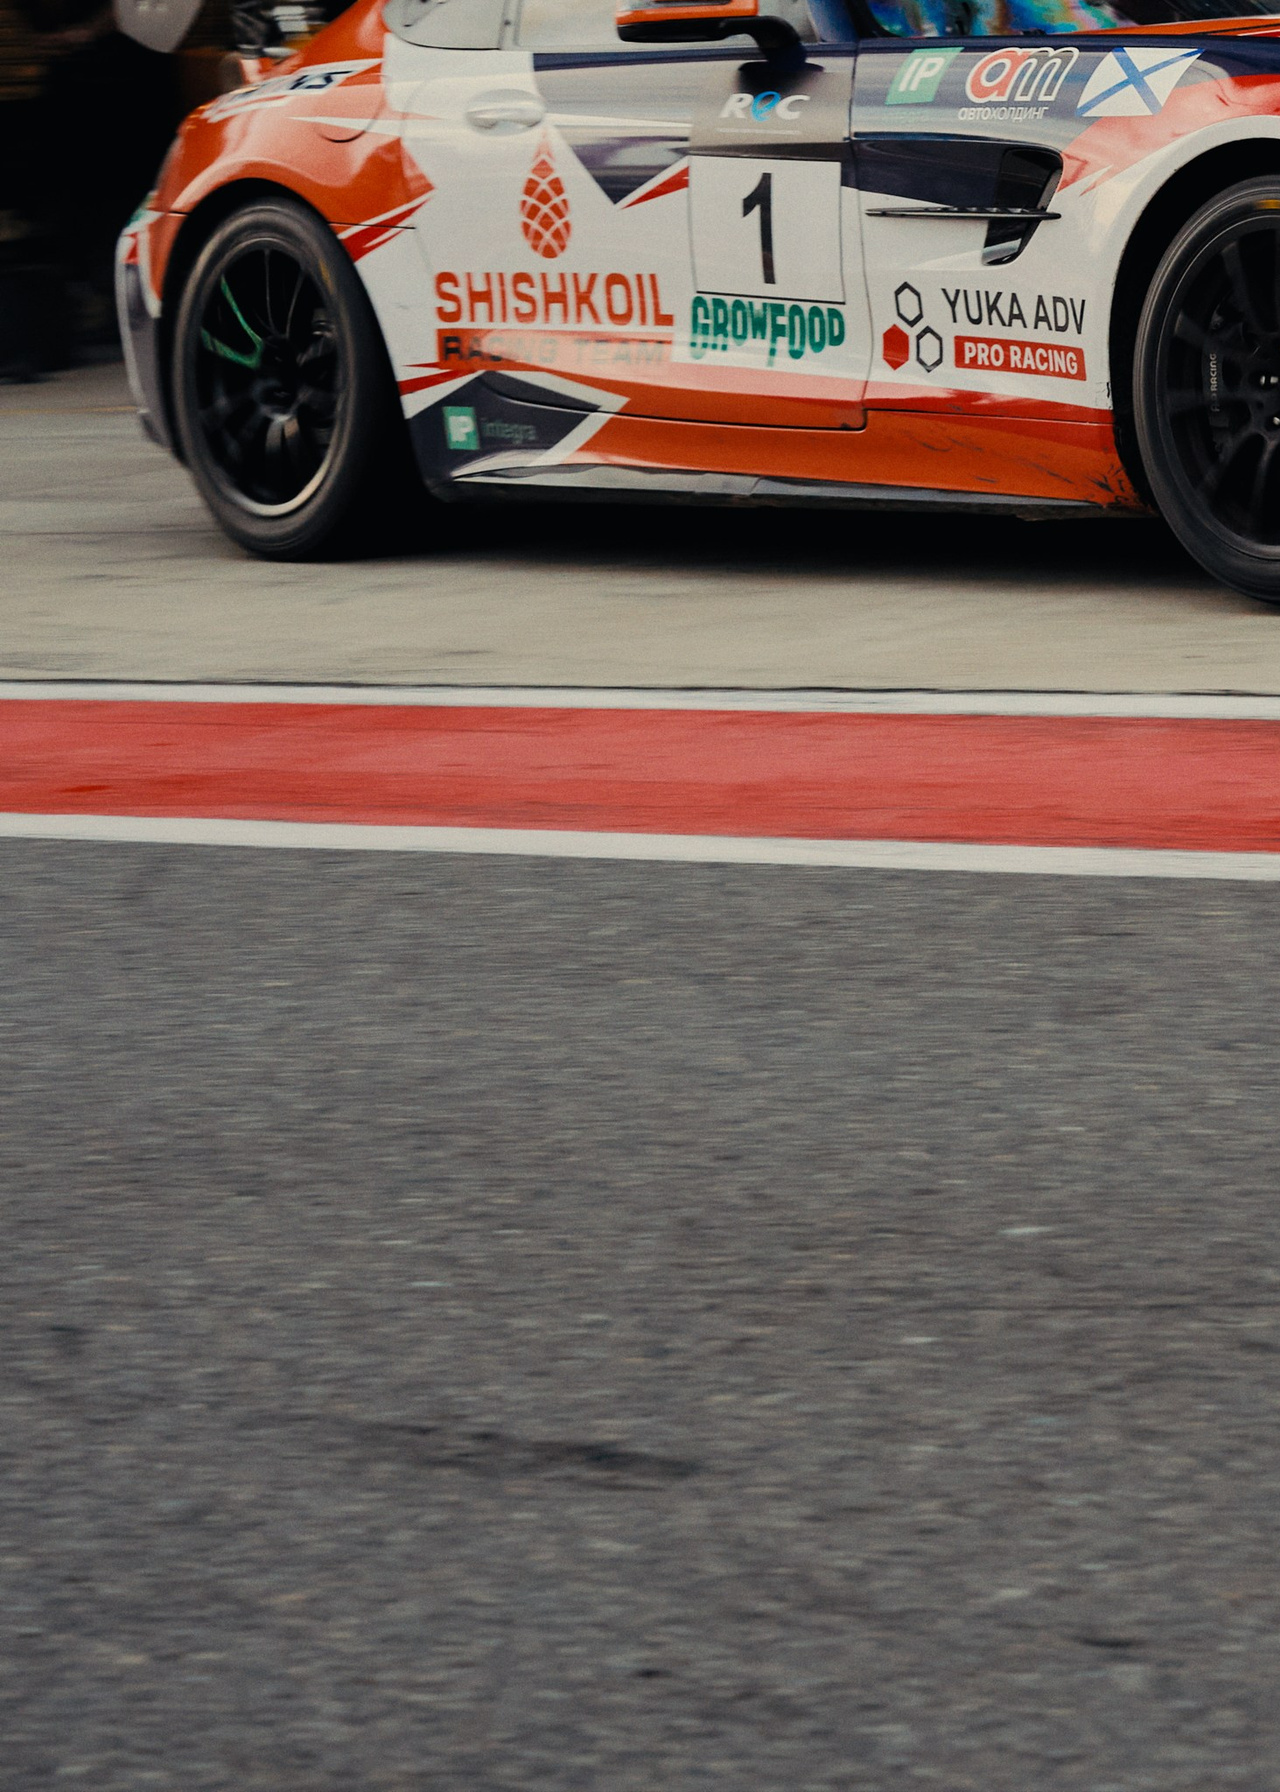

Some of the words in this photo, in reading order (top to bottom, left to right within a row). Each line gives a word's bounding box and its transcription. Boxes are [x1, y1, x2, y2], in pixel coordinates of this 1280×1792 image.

[742, 172, 776, 285] 1
[434, 271, 674, 326] SHISHKOIL
[941, 288, 1027, 328] YUKA
[1034, 295, 1086, 334] ADV
[574, 338, 664, 364] TEAM
[964, 342, 1004, 366] PRO
[1010, 345, 1078, 375] RACING
